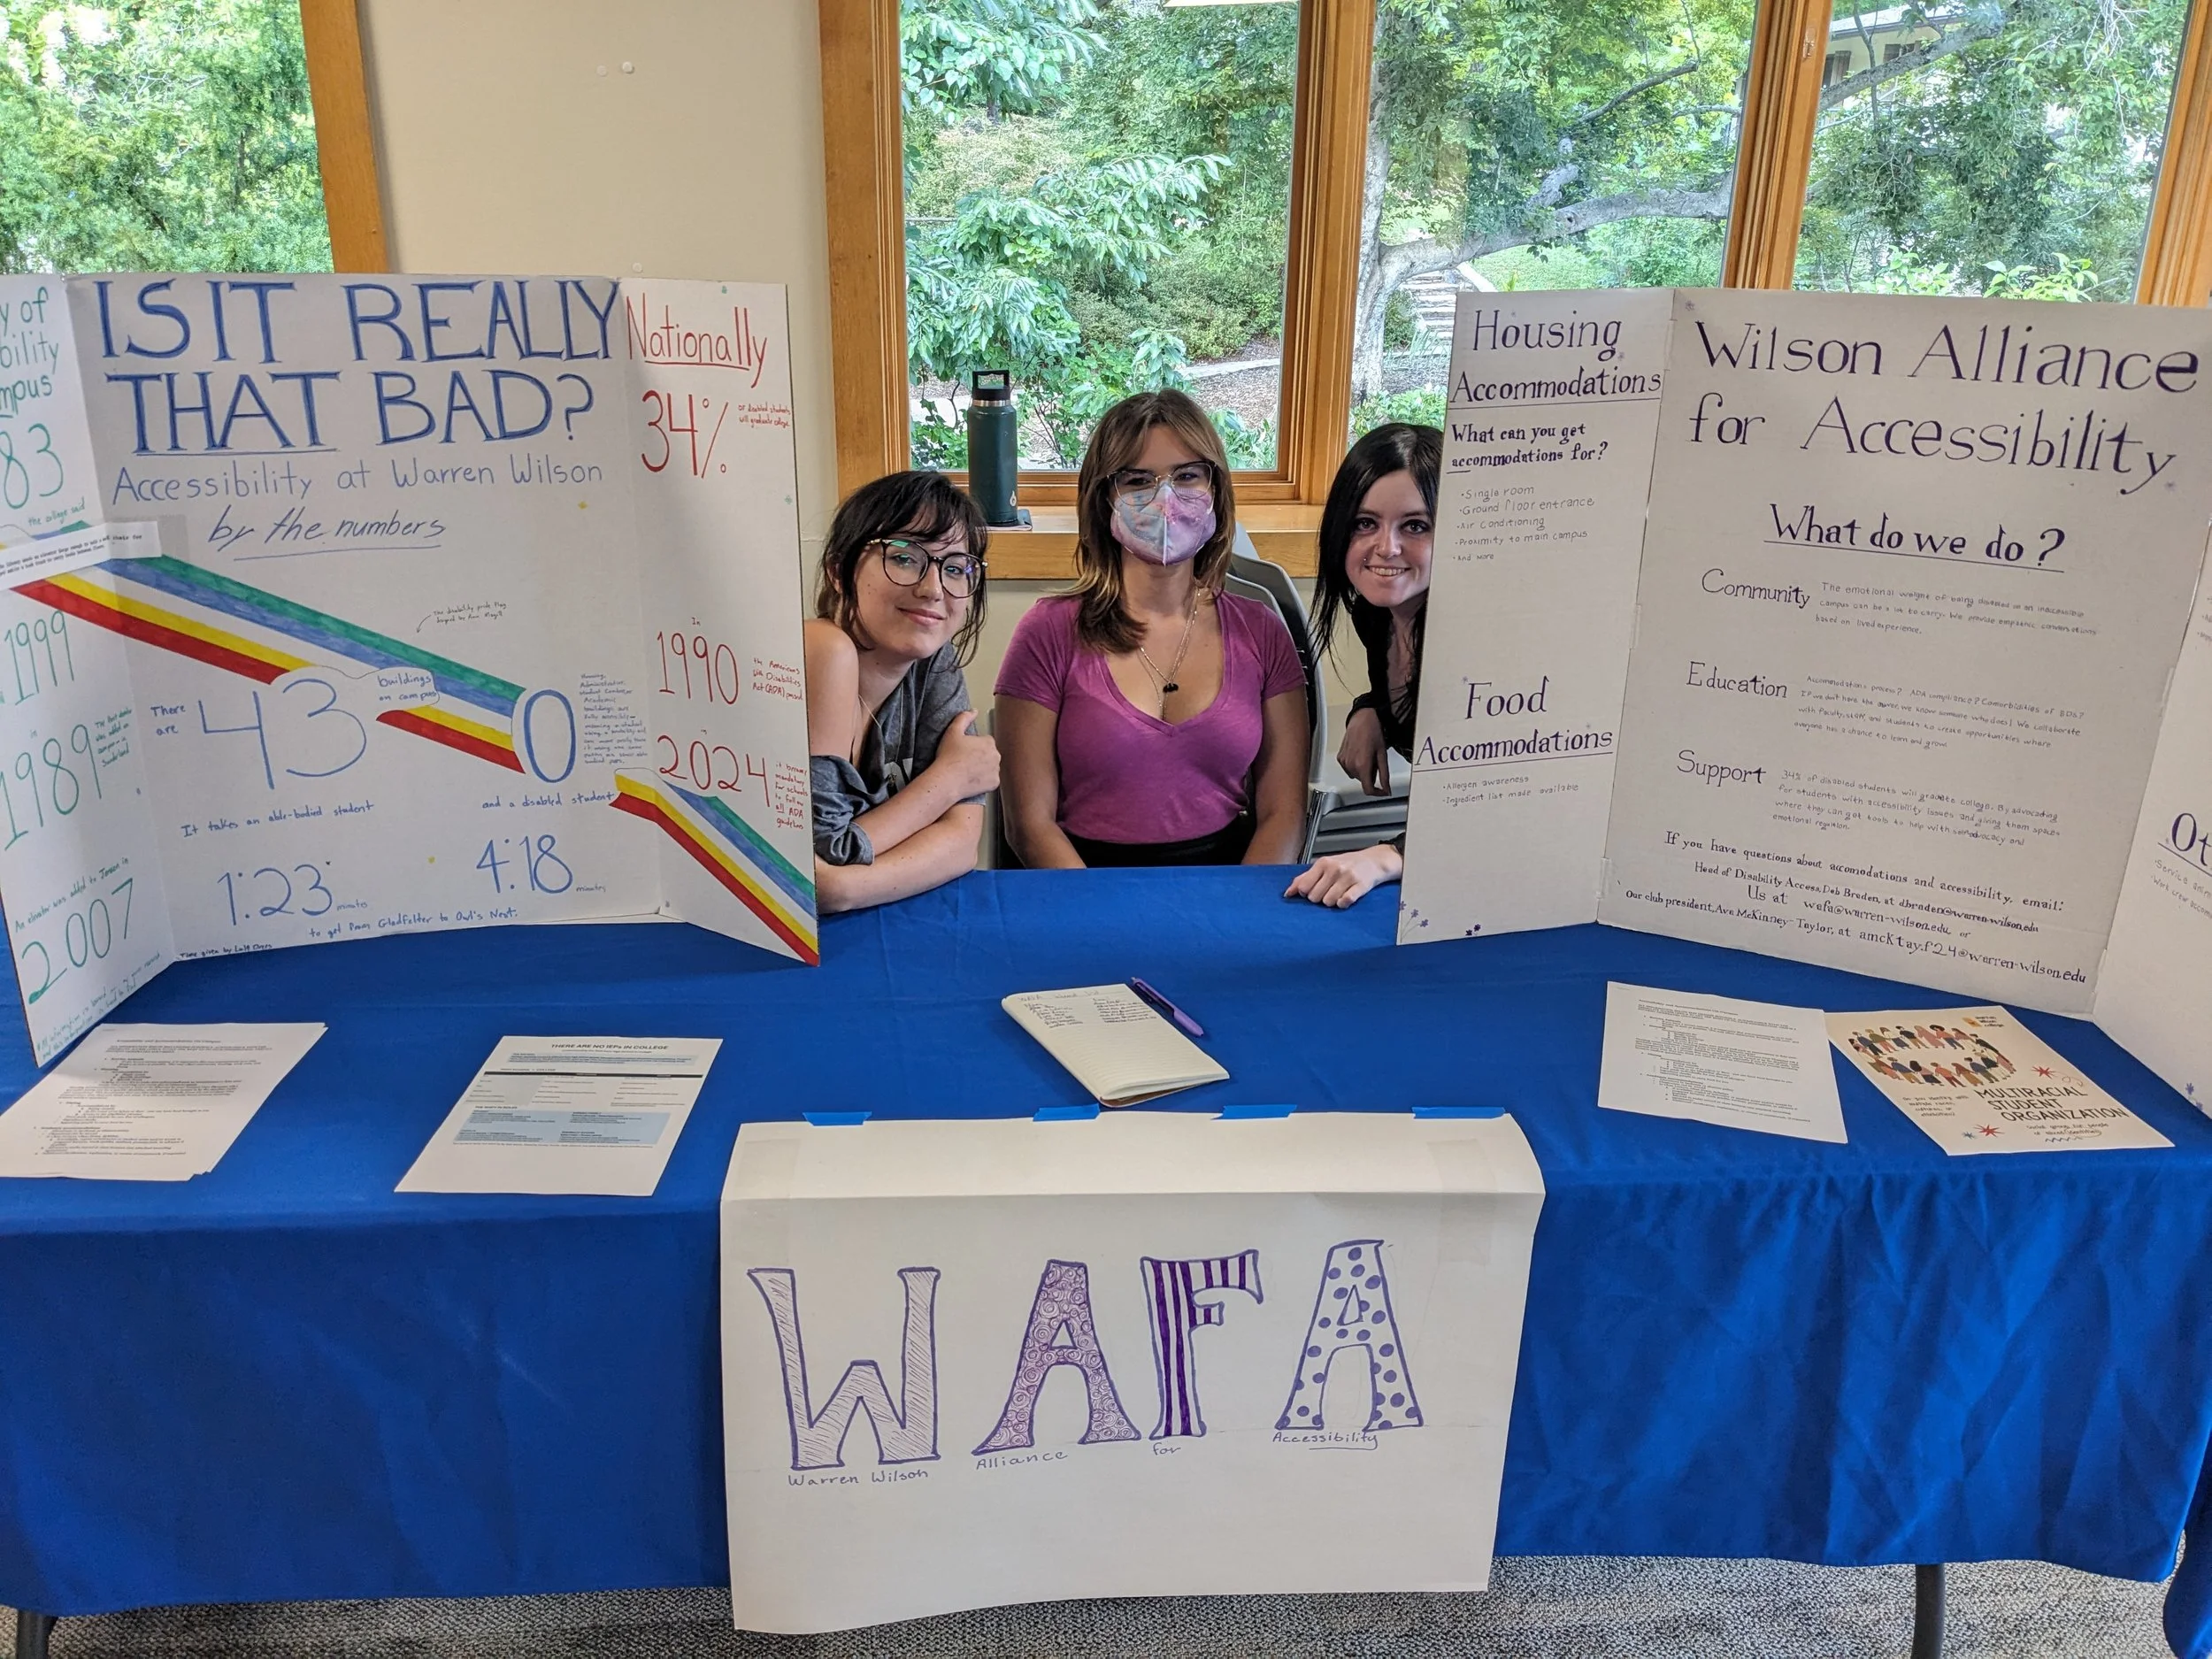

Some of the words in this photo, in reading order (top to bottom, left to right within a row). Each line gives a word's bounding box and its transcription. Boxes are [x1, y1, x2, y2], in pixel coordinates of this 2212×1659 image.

[20, 286, 49, 324] of
[93, 279, 190, 359] IS
[207, 280, 296, 364] IT
[341, 278, 621, 364] REALLY
[626, 292, 767, 388] Nationally
[1472, 310, 1623, 362] Housing
[1695, 320, 1882, 376] Wilson
[1907, 323, 2199, 394] Alliance
[0, 375, 52, 415] mpus
[1449, 365, 1662, 403] Accommodations
[104, 370, 342, 453] THAT
[370, 369, 594, 446] BAD?
[641, 389, 729, 479] 34%
[1451, 423, 1494, 443] What
[1500, 426, 1525, 441] can
[1532, 426, 1556, 443] you
[1561, 424, 1586, 445] get
[1689, 391, 1765, 446] for
[1800, 395, 2177, 495] Accessibility
[0, 423, 64, 510] 83
[1451, 448, 1563, 468] accommodations
[1571, 442, 1609, 461] for?
[112, 460, 313, 505] Accessibility
[337, 459, 372, 488] at
[390, 458, 495, 488] Warren
[510, 453, 603, 484] Wilson
[1504, 487, 1534, 495] room
[1462, 503, 1499, 515] Ground
[1505, 499, 1535, 511] floor
[1540, 497, 1595, 510] entrance
[208, 504, 255, 551] by
[265, 505, 325, 545] the
[336, 510, 447, 538] numbers
[1460, 521, 1475, 530] Air
[1524, 533, 1548, 541] main
[1552, 531, 1588, 543] campus
[1770, 503, 1861, 546] What
[1870, 511, 1904, 550] do
[1913, 530, 1967, 556] we
[1701, 567, 1811, 610] Community
[1816, 613, 1838, 623] based
[1857, 618, 1876, 628] lived
[4, 611, 74, 706] 1999
[657, 630, 739, 705] 1990
[378, 669, 433, 687] buildings
[398, 689, 439, 704] campus
[764, 683, 785, 698] (ADA)
[765, 671, 802, 687] Disabilities
[1686, 661, 1787, 699] Education
[1806, 675, 1867, 689] Accommodations
[1910, 688, 1926, 697] ADA
[1981, 697, 2039, 713] Comorbidities
[150, 704, 186, 717] There
[1464, 675, 1550, 720] Food
[156, 725, 178, 735] are
[198, 678, 367, 790] 43
[1414, 728, 1613, 766] Accommodations
[657, 734, 771, 808] 2024
[1447, 781, 1478, 792] Allergen
[1482, 776, 1529, 787] awareness
[1677, 748, 1767, 787] Support
[482, 795, 501, 809] and
[522, 793, 563, 808] disabled
[571, 790, 617, 804] student
[1446, 794, 1484, 808] Ingredient
[1509, 789, 1532, 798] made
[1540, 783, 1579, 795] available
[1781, 770, 1801, 780] 34%
[1819, 776, 1855, 787] disabled
[1858, 783, 1896, 795] students
[1998, 804, 2008, 814] By
[2011, 808, 2058, 823] advocating
[180, 825, 198, 837] It
[208, 818, 239, 831] takes
[268, 805, 323, 822] able-bodied
[334, 800, 375, 817] student
[476, 833, 574, 895] 4:18
[1664, 830, 1680, 845] If
[1682, 839, 1703, 849] you
[1710, 838, 1737, 855] have
[1743, 849, 1792, 864] questions
[1796, 854, 1823, 869] about
[1829, 862, 1908, 883] accomodations
[1914, 876, 1935, 888] and
[2022, 897, 2064, 911] email:
[2155, 860, 2188, 885] Service
[217, 864, 333, 926] 1:23
[1694, 862, 1719, 875] Head
[1721, 867, 1732, 877] of
[1735, 868, 1783, 887] Disability
[1823, 884, 1840, 896] Deb
[1843, 887, 1881, 904] Braden,
[1884, 895, 1895, 906] at
[1747, 884, 1766, 902] Us
[1772, 892, 1788, 905] at
[309, 927, 320, 938] to
[327, 924, 342, 939] get
[349, 922, 371, 932] from
[378, 913, 434, 928] Gladfelter
[440, 911, 449, 922] to
[456, 910, 483, 921] Owl's
[1625, 890, 1643, 900] Our
[1644, 891, 1664, 904] club
[1665, 895, 1715, 913] president,
[1715, 905, 1734, 916] Ava
[1838, 927, 1851, 938] at
[21, 878, 133, 1005] 2007
[1974, 1086, 2088, 1099] MULTIRACIAL
[1988, 1099, 2063, 1110] STUDENT
[2001, 1108, 2129, 1122] ORGANIZATION
[1151, 1442, 1182, 1457] for
[1271, 1429, 1379, 1451] Accessibility
[788, 1472, 859, 1487] Warren
[871, 1468, 929, 1486] Wilson
[975, 1448, 1069, 1471] Alliance
